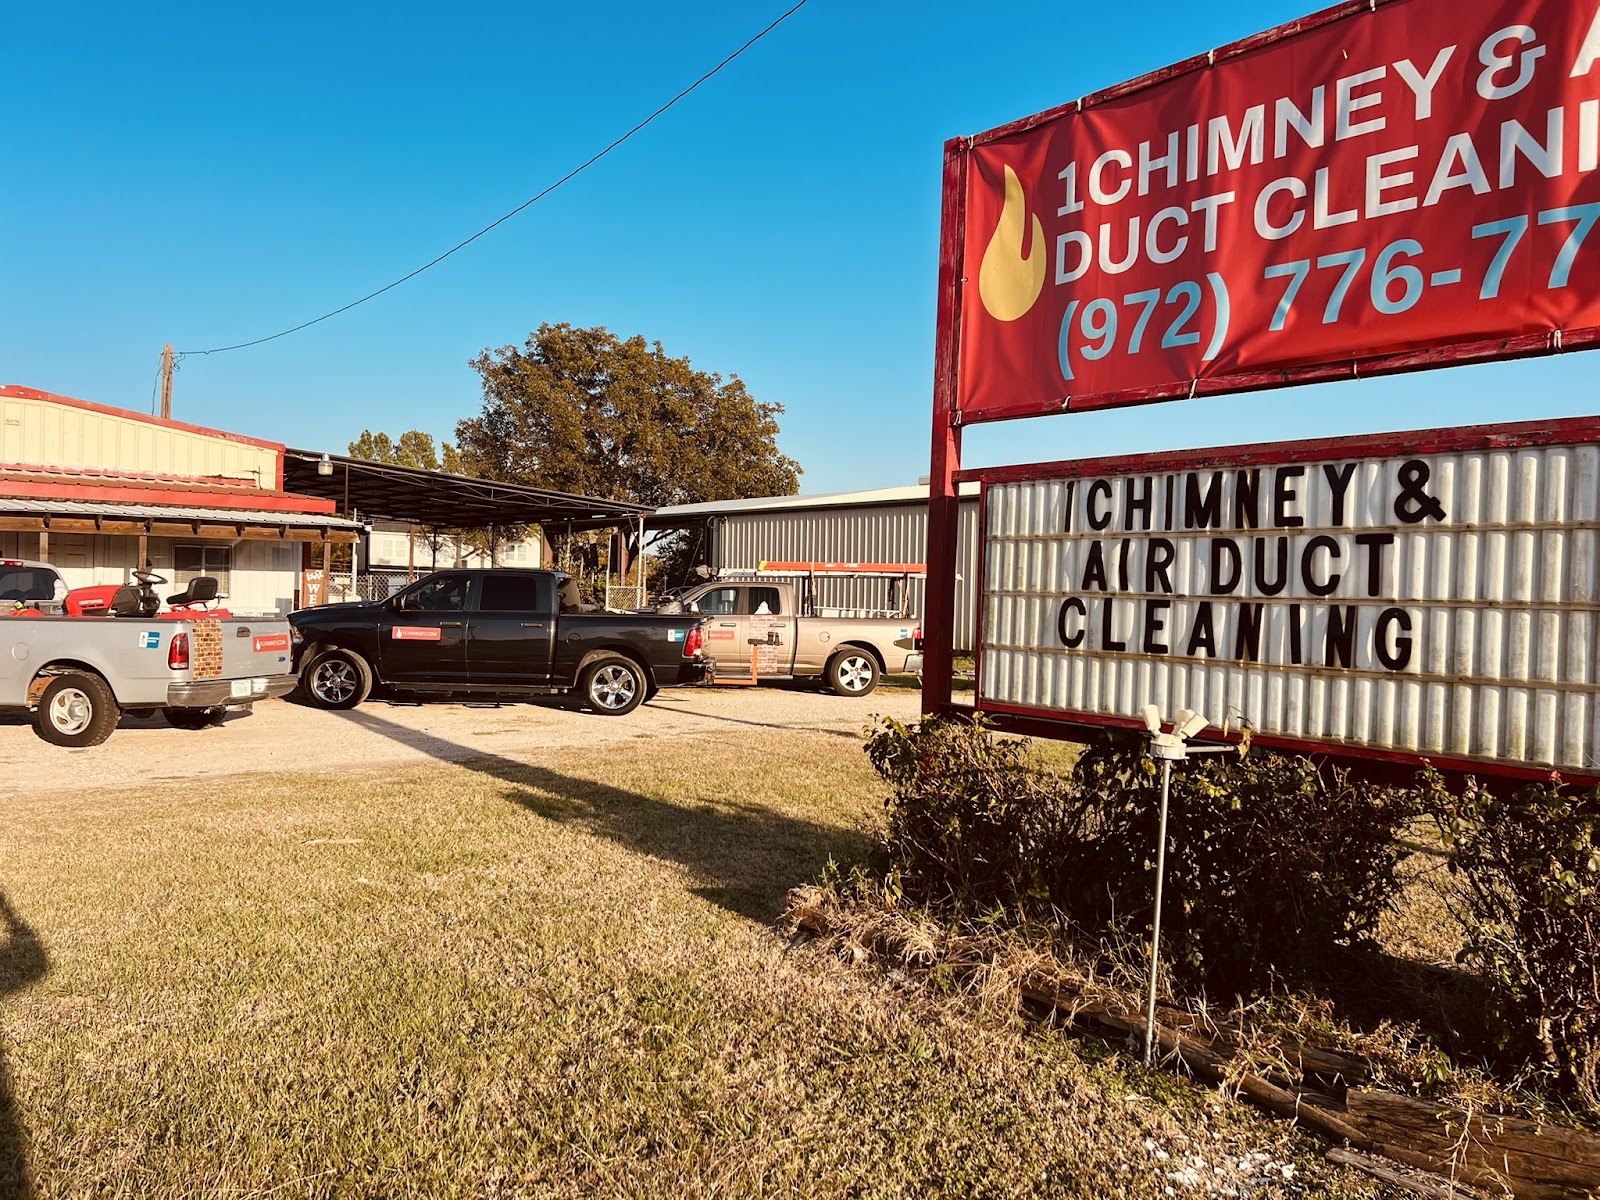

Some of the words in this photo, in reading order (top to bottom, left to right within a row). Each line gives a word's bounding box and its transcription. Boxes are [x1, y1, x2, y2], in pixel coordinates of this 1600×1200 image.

[1056, 45, 1455, 217] 1CHIMNEY
[1477, 25, 1546, 100] &
[1056, 191, 1235, 286] DUCT
[1058, 273, 1230, 379] (972)
[1265, 202, 1600, 332] 776-77
[1065, 463, 1356, 532] 1CHIMNEY
[1394, 460, 1447, 523] &
[1081, 538, 1175, 592] AIR
[1210, 533, 1394, 597] DUCT
[1058, 597, 1413, 671] CLEANING
